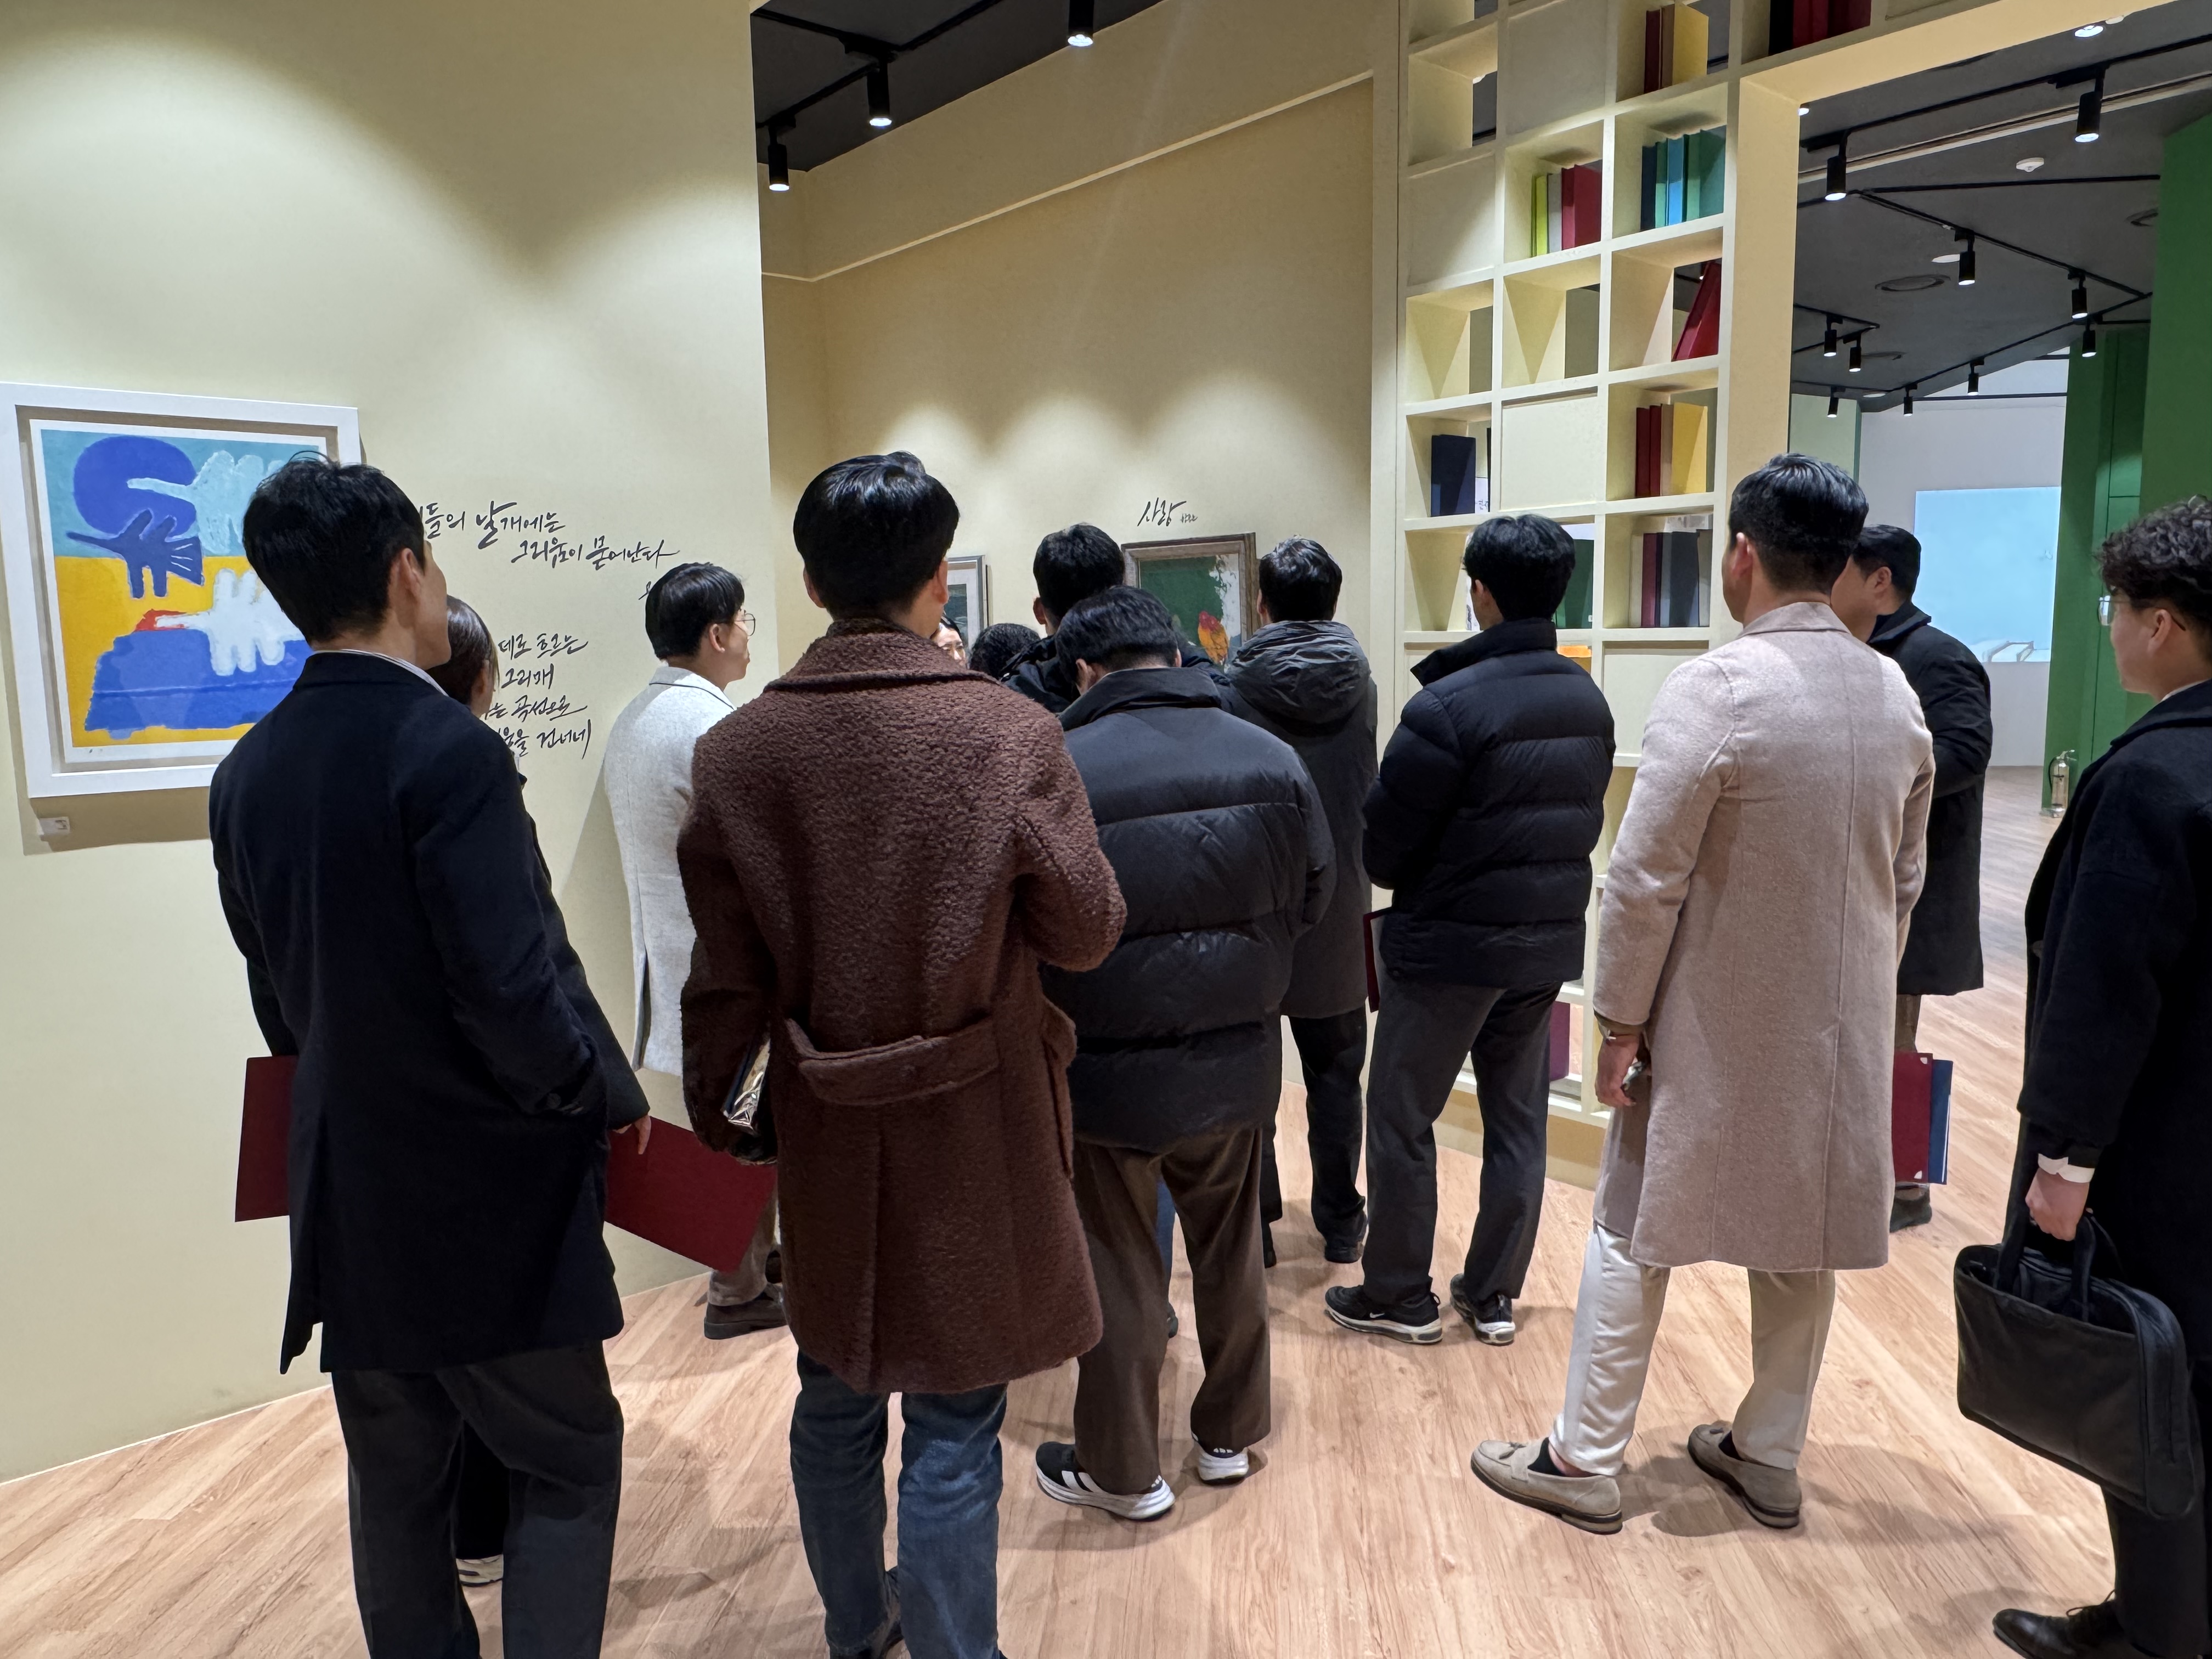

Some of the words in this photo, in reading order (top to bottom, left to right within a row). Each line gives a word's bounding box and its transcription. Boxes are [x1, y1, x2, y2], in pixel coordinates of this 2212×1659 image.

[476, 500, 566, 549] 날개에는
[1137, 497, 1187, 527] 사랑
[511, 537, 583, 569] 그리움이
[536, 633, 589, 659] 흐르는
[511, 695, 588, 723] 곡선으로
[536, 719, 591, 760] 건너네
